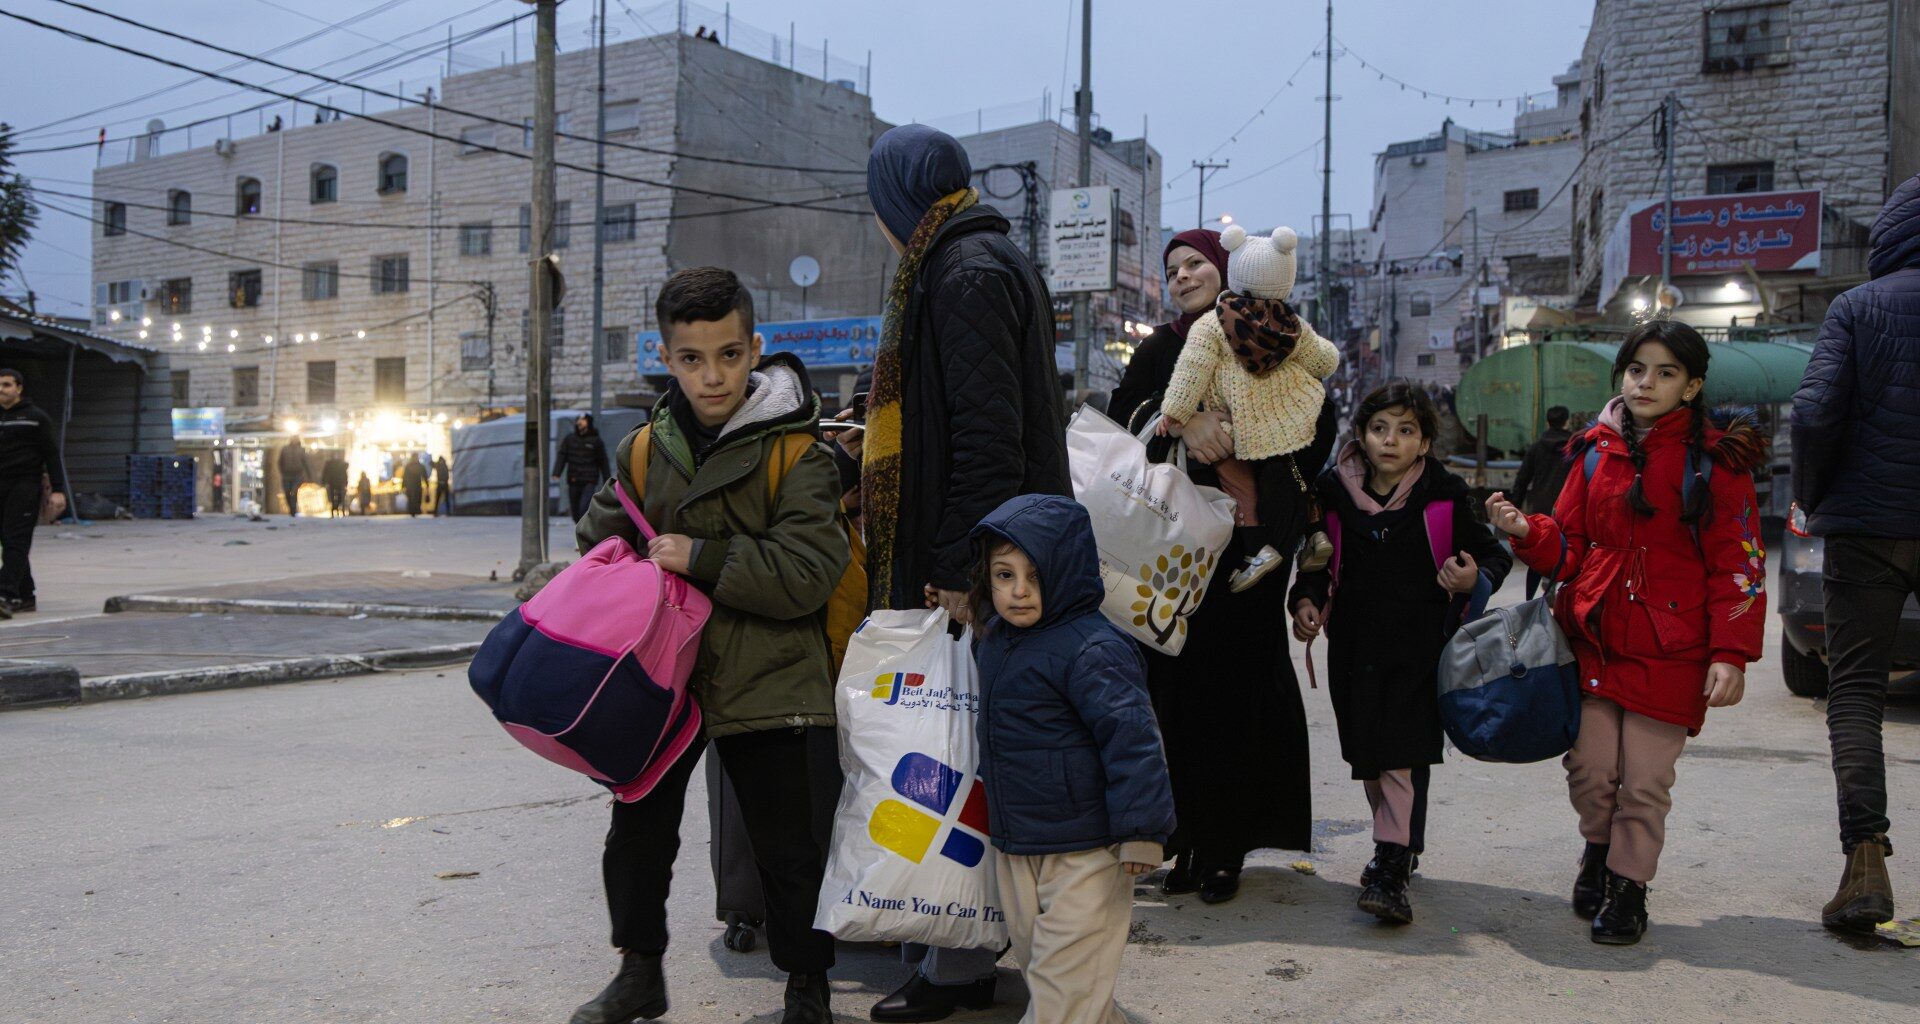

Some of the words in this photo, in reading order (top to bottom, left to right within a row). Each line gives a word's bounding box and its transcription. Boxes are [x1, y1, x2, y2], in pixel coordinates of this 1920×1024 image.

[1717, 206, 1730, 227] و
[1733, 200, 1805, 221] ملحمة
[1657, 233, 1697, 257] زيد
[1701, 236, 1731, 257] بن
[1734, 228, 1793, 254] طارق
[902, 687, 923, 697] Beit
[945, 686, 979, 702] Para
[842, 889, 853, 904] A
[858, 890, 906, 911] Name
[911, 897, 941, 916] You
[946, 901, 977, 919] Can
